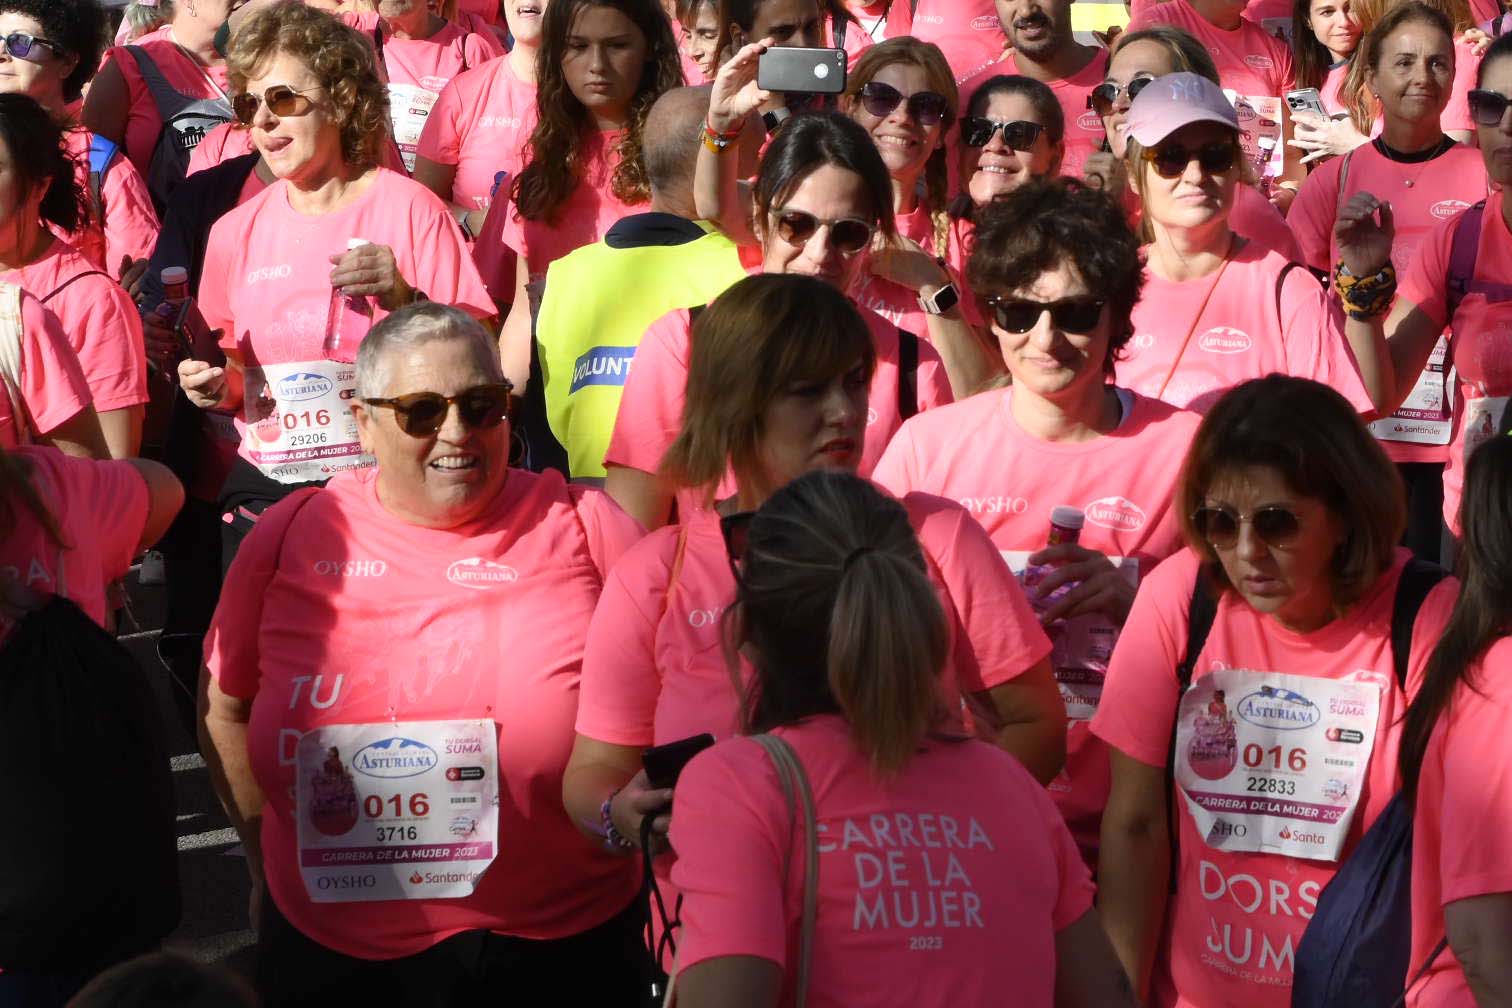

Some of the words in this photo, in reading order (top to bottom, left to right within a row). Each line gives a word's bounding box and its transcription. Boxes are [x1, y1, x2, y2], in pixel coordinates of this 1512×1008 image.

[573, 356, 634, 383] VOLUNT
[284, 408, 331, 430] 016
[291, 432, 327, 446] 29206
[260, 452, 294, 462] CARRERA
[295, 451, 307, 459] DE
[308, 449, 319, 458] LA
[320, 446, 348, 456] MUJER
[331, 460, 377, 473] Santander
[1089, 506, 1144, 528] ASTURIANA
[313, 559, 387, 578] OYSHO
[452, 568, 514, 582] ASTURIANA
[688, 606, 724, 628] OY
[288, 673, 345, 710] TU
[1243, 701, 1313, 723] ASTURIANA
[1329, 703, 1365, 717] SUMA
[446, 744, 482, 754] SUMA
[1243, 743, 1308, 772] 016
[359, 755, 432, 770] ASTURIANA
[1247, 776, 1296, 796] 22833
[364, 792, 430, 819] 016
[1195, 793, 1248, 811] CARRERA
[1250, 801, 1265, 812] DE
[1267, 802, 1281, 813] LA
[1283, 804, 1320, 819] MUJER
[1322, 808, 1343, 821] 202
[376, 826, 418, 842] 3716
[1292, 830, 1326, 845] Santa
[322, 851, 374, 863] CARRERA
[376, 850, 393, 861] DE
[394, 849, 410, 860] LA
[411, 848, 450, 859] MUJER
[454, 846, 479, 857] 2023
[855, 850, 910, 890] DE
[921, 850, 972, 887] LA
[317, 874, 376, 890] OYSHO
[1200, 859, 1321, 920] DORS
[852, 890, 985, 931] MUJER
[909, 936, 943, 951] 2023
